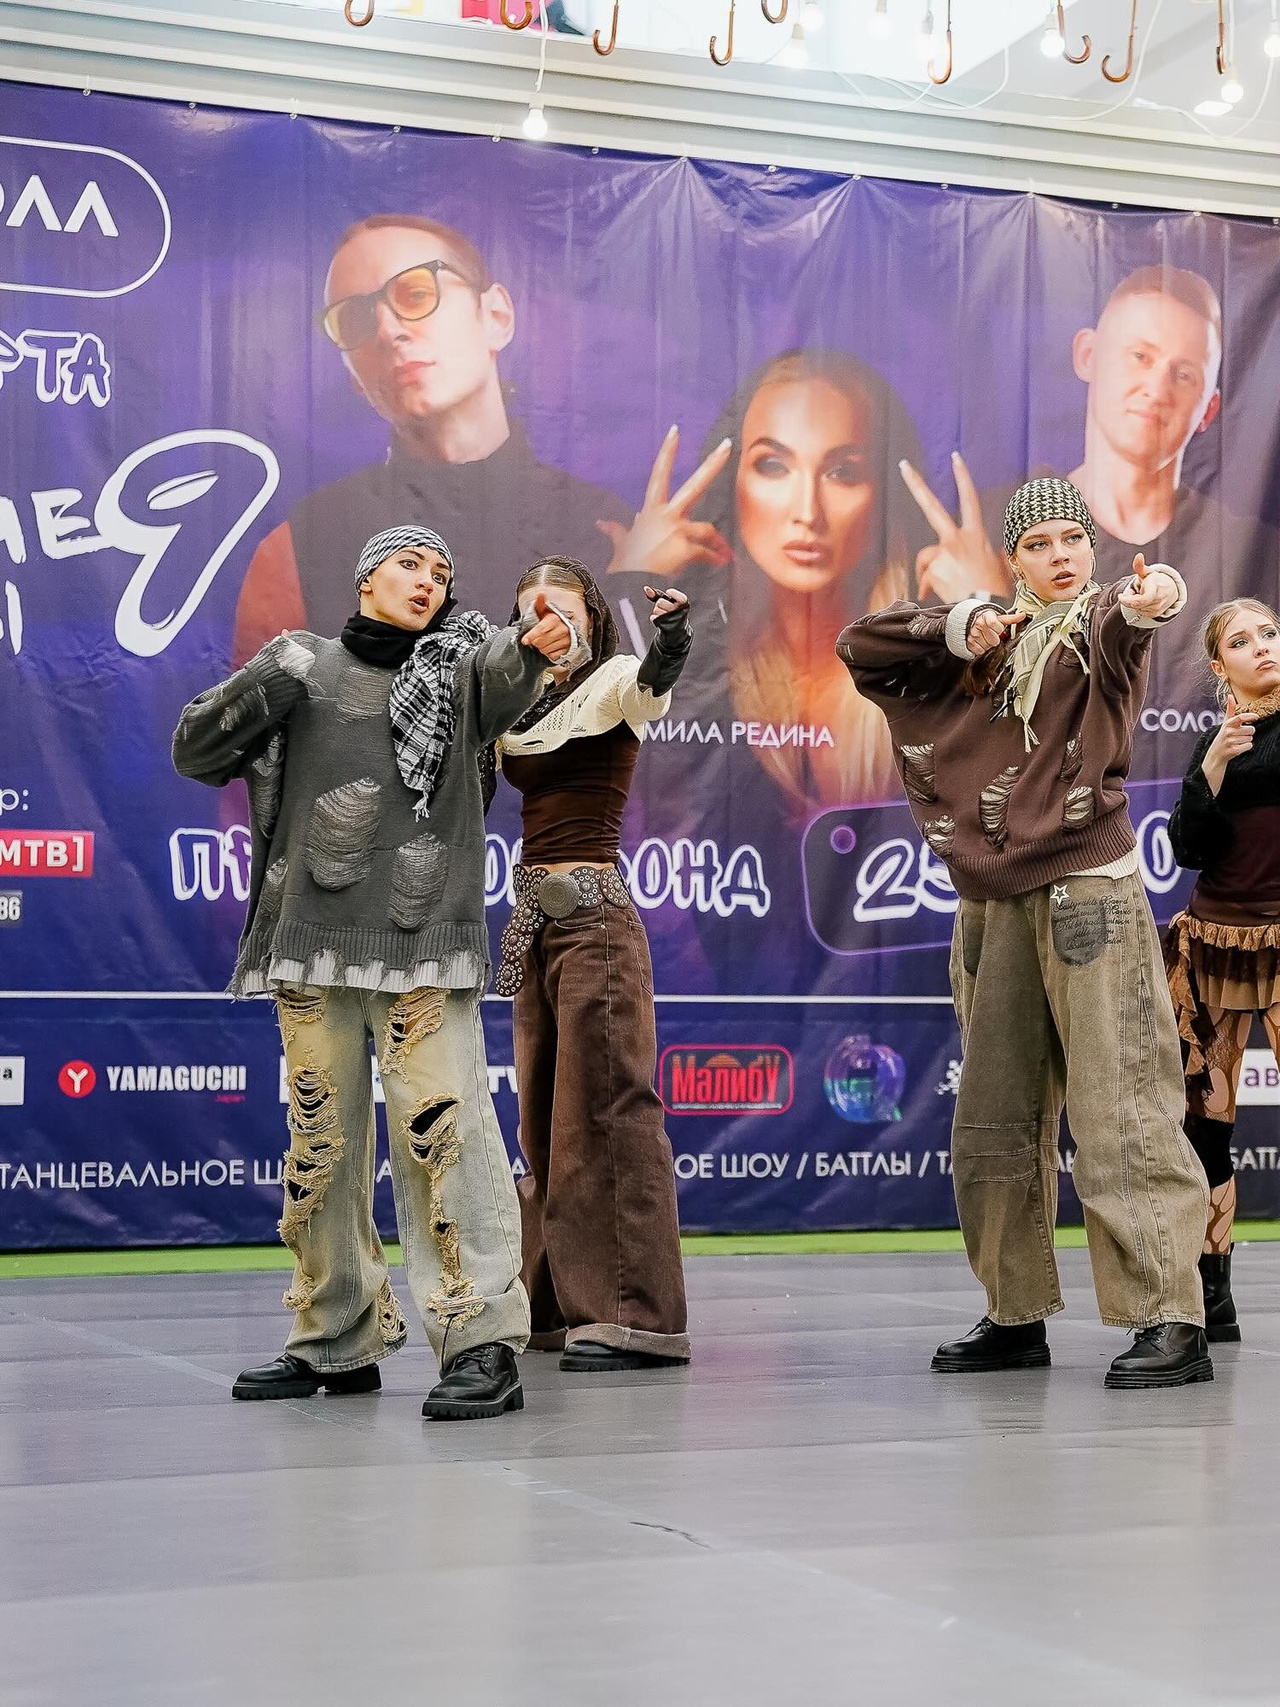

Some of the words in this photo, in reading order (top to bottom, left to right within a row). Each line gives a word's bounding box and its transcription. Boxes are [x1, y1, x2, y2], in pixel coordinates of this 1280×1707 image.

[0, 174, 119, 237] ЛЛ
[731, 721, 835, 748] РЕДИНА
[106, 1065, 247, 1091] YAMAGUCHI
[0, 1159, 245, 1191] ТАНЦЕВАЛЬНОЕ
[721, 1153, 789, 1178] ШОУ
[815, 1151, 911, 1177] БАТТЛЫ
